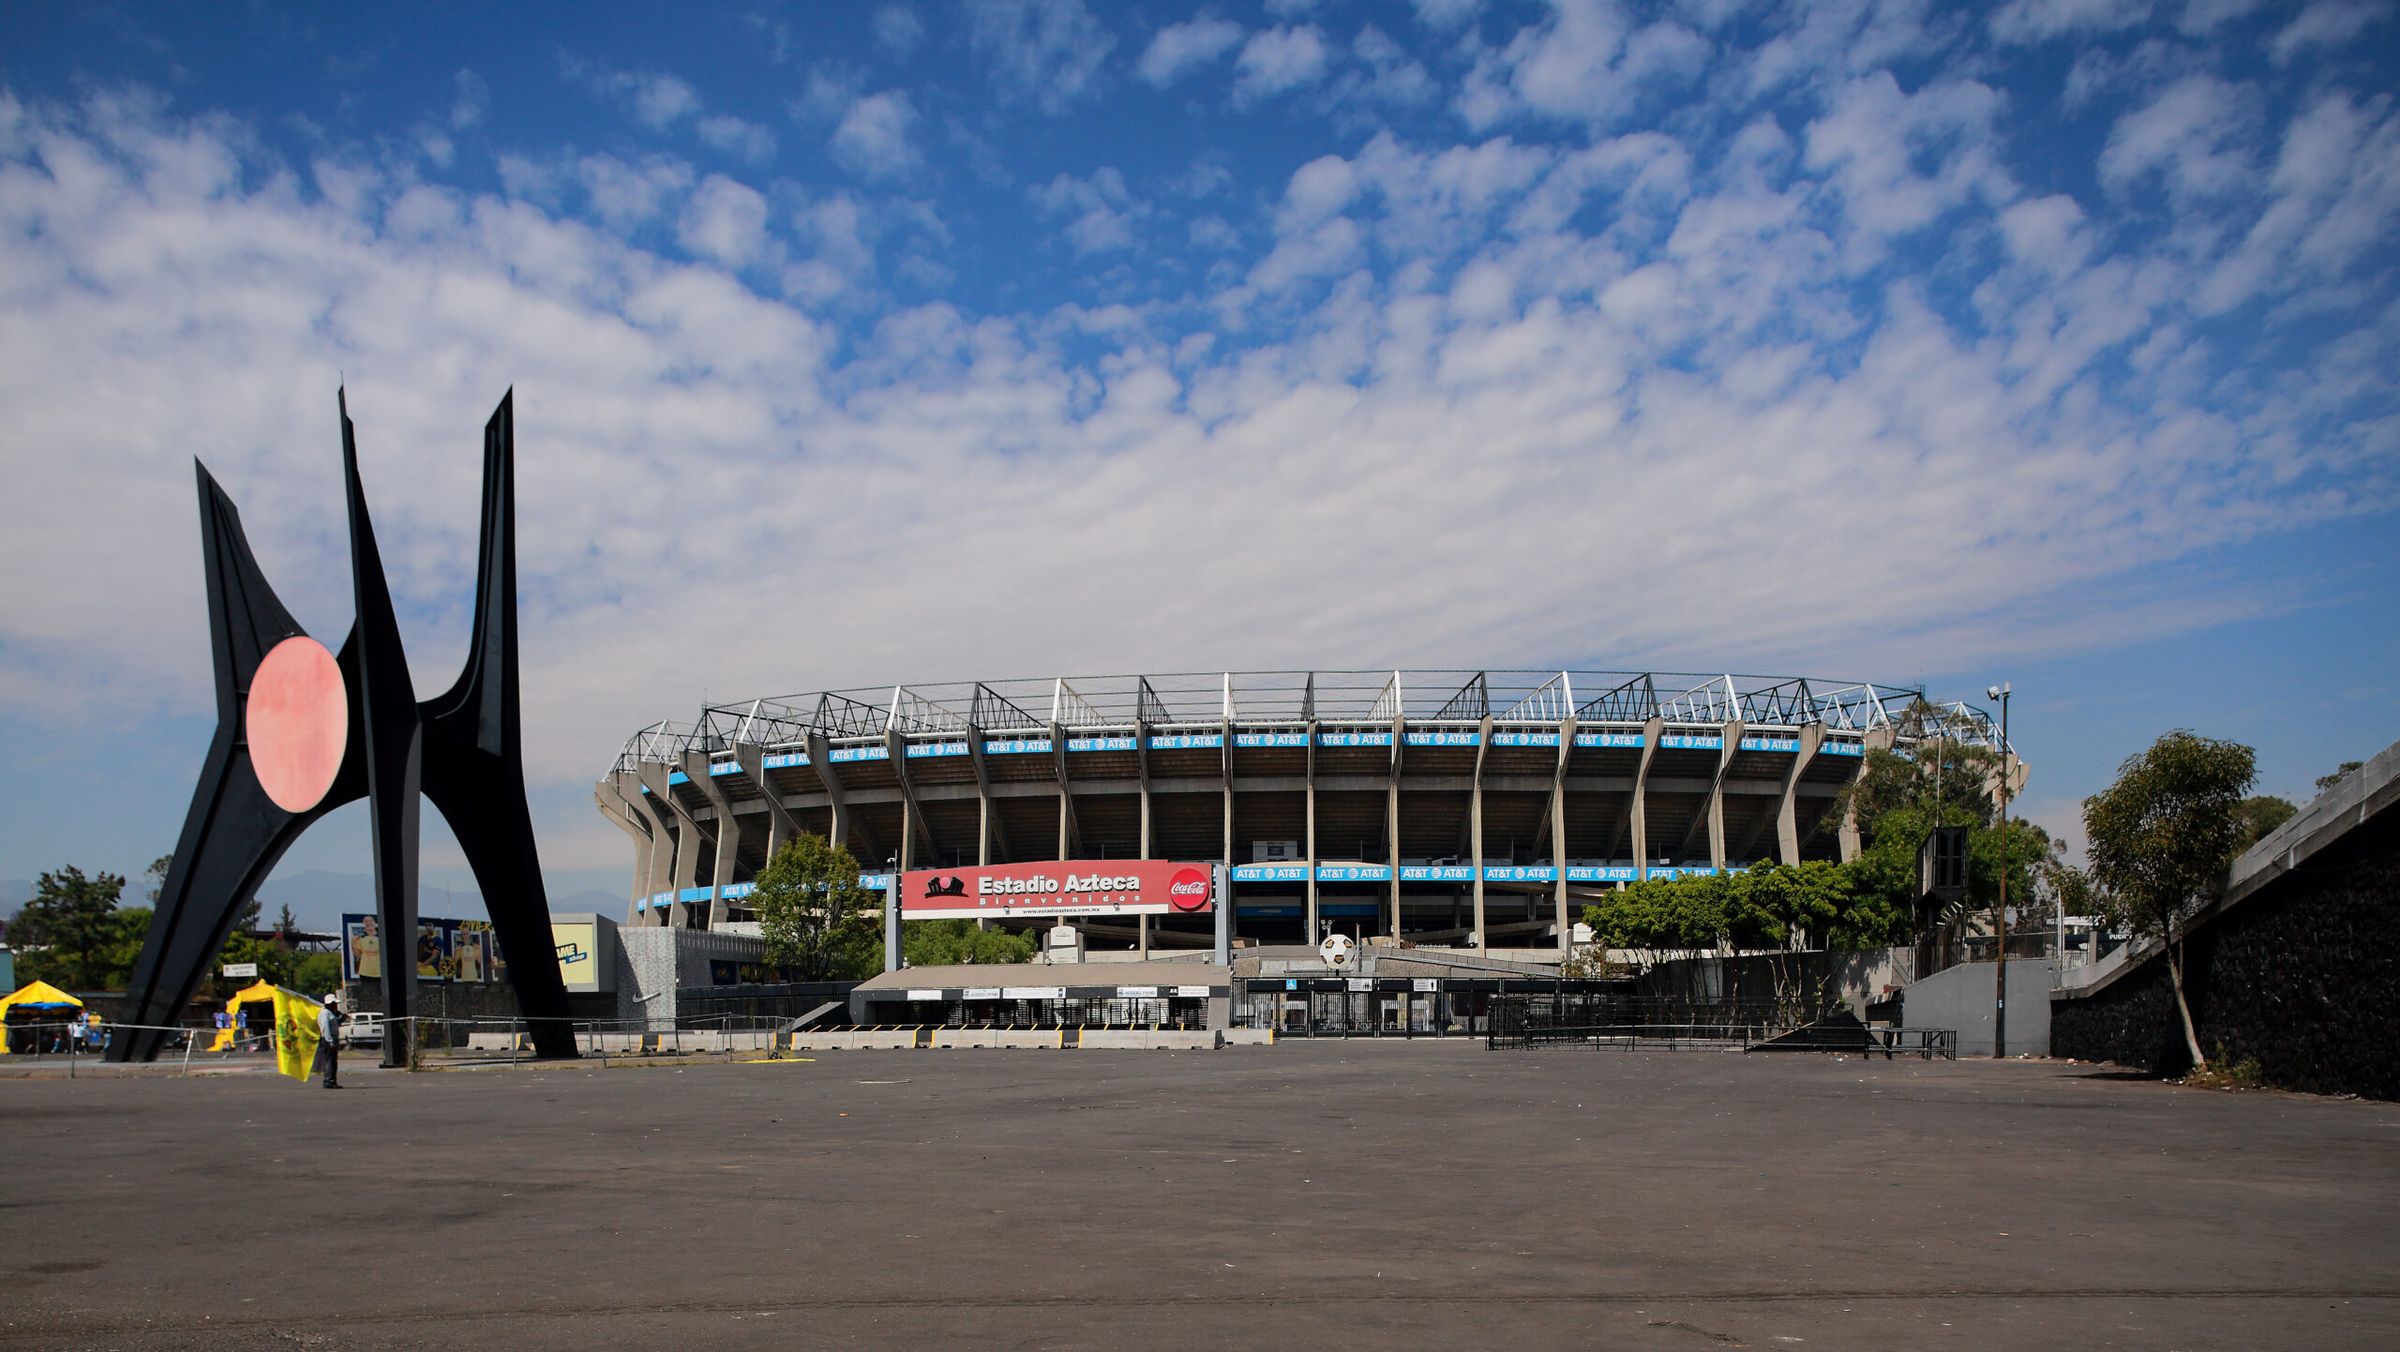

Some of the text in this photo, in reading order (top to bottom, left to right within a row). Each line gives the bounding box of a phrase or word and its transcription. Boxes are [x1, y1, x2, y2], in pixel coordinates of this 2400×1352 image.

[1068, 738, 1132, 750] AT&T AT&T
[1152, 735, 1218, 747] AT&T AT&T
[1237, 735, 1301, 745] AT&T AT&T
[1322, 735, 1386, 745] AT&T AT&T
[1408, 734, 1472, 744] AT&T AT&T
[1491, 735, 1555, 745] AT&T AT&T
[1613, 736, 1637, 746] AT&T
[1662, 736, 1719, 748] T&T AT&T
[1741, 738, 1793, 750] T&T AT&T
[907, 743, 968, 755] AT&T AT&T
[987, 740, 1052, 752] AT&T AT&T
[1840, 744, 1859, 754] AT&T
[832, 751, 854, 761] AT&T
[766, 756, 786, 768] AT&T
[1236, 867, 1302, 879] AT&T AT&T
[1319, 867, 1386, 878] AT&T AT&T
[1403, 867, 1469, 878] AT&T AT&T
[1487, 868, 1551, 879] AT&T AT&T
[1568, 869, 1632, 879] AT&T AT&T
[1649, 870, 1673, 879] AT&T
[978, 874, 1140, 895] Estadio Azteca
[724, 886, 740, 897] AT&T
[979, 896, 1140, 905] Bienvenidos
[1023, 907, 1100, 915] www.estadioazteca.com.mx
